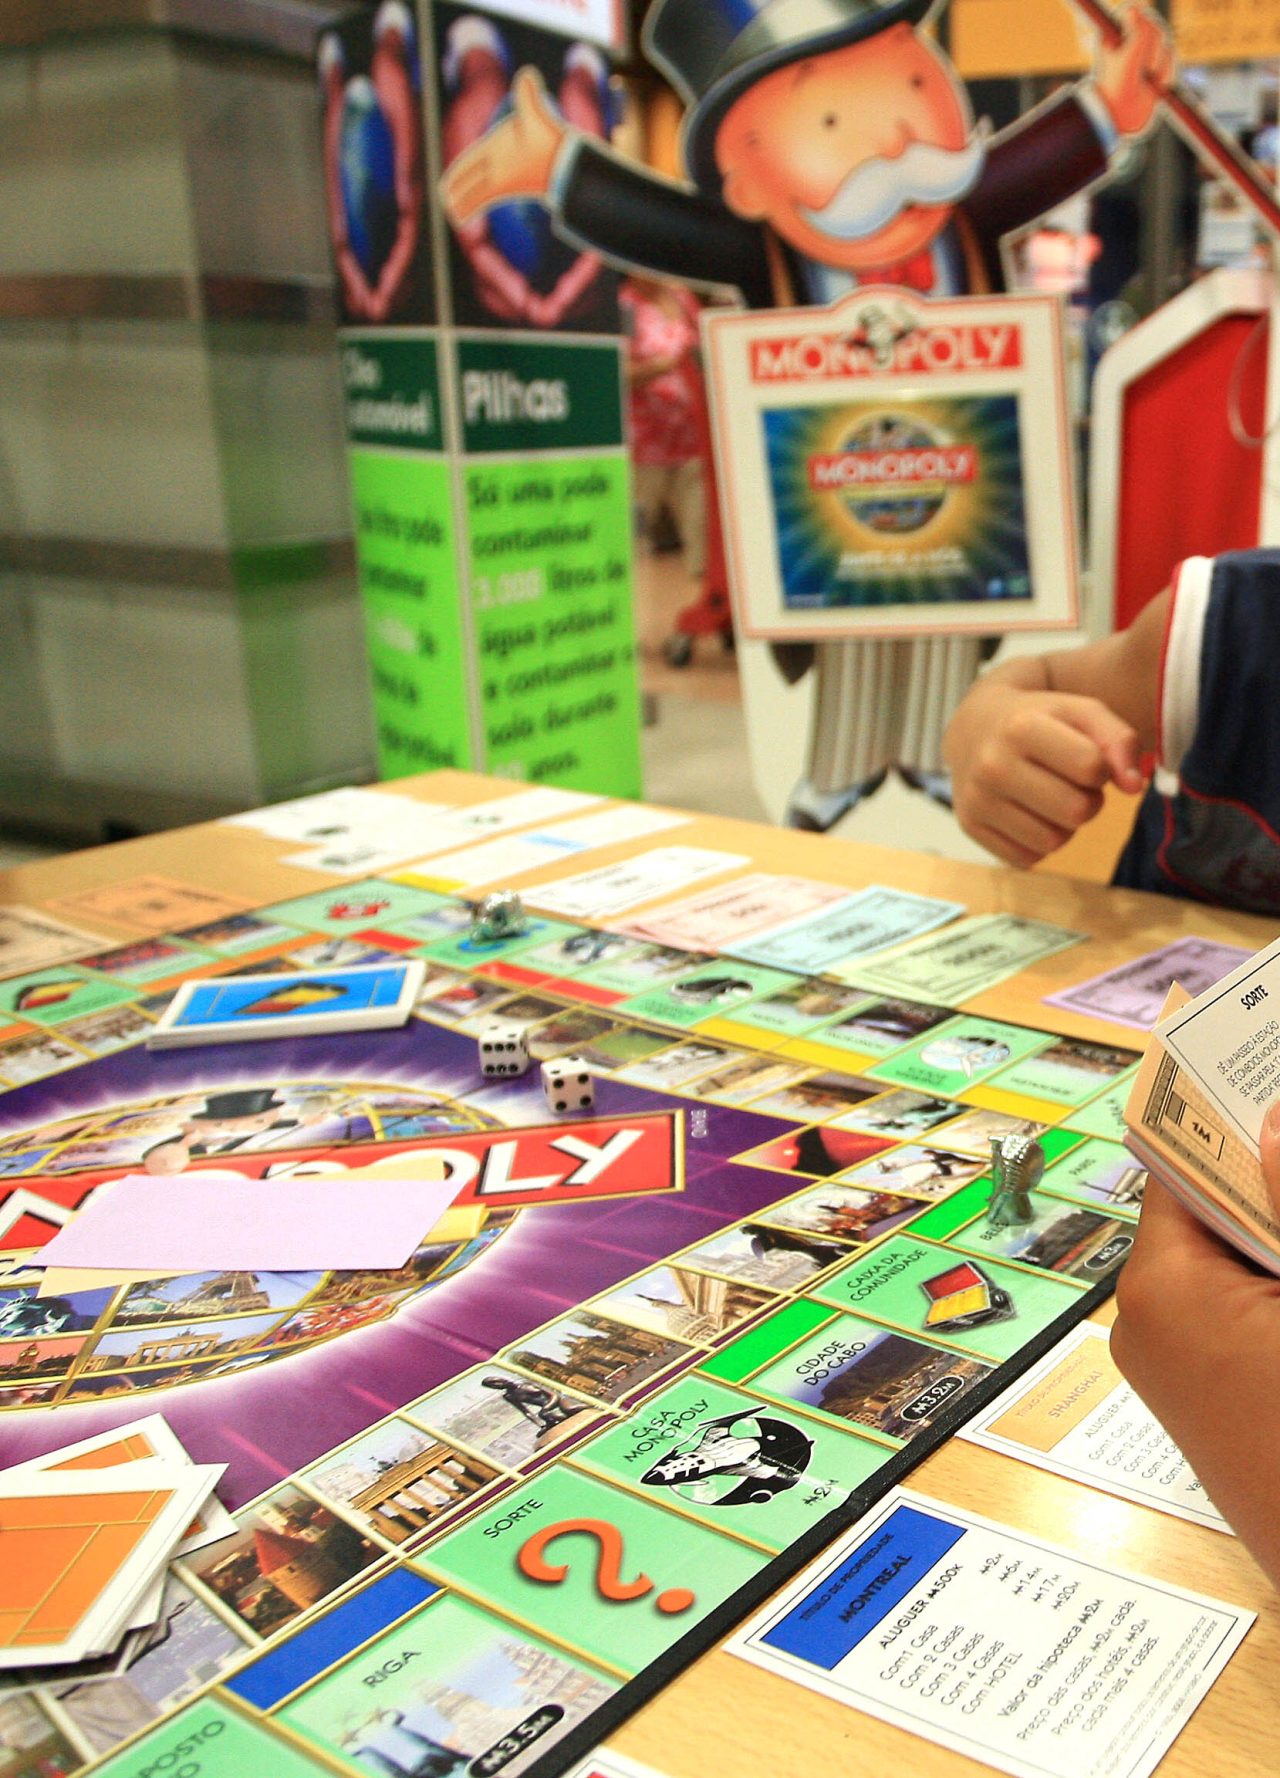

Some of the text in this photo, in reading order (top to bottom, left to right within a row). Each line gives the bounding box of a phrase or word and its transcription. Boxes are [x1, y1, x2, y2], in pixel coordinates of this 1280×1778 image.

[814, 452, 969, 484] MONOPOLY
[1241, 984, 1269, 1010] SORTE
[847, 1252, 904, 1290] CAIXA DA
[850, 1249, 928, 1302] COMUNIDADE
[796, 1340, 846, 1375] CIDADE
[804, 1341, 867, 1386] DO CABO
[623, 1398, 710, 1463] MONOPOLY
[632, 1408, 676, 1440] CASA
[483, 1497, 544, 1540] SORTE
[838, 1555, 912, 1623] MONTREAL
[880, 1600, 929, 1649] ALUGUER
[362, 1650, 422, 1690] RIGA
[899, 1665, 928, 1688] Com
[920, 1673, 948, 1697] Com
[961, 1653, 1023, 1714] Com HOTEL
[998, 1689, 1027, 1716] Valor
[1037, 1625, 1082, 1672] hipoteca
[940, 1681, 969, 1705] Com
[1016, 1709, 1050, 1740] Preço
